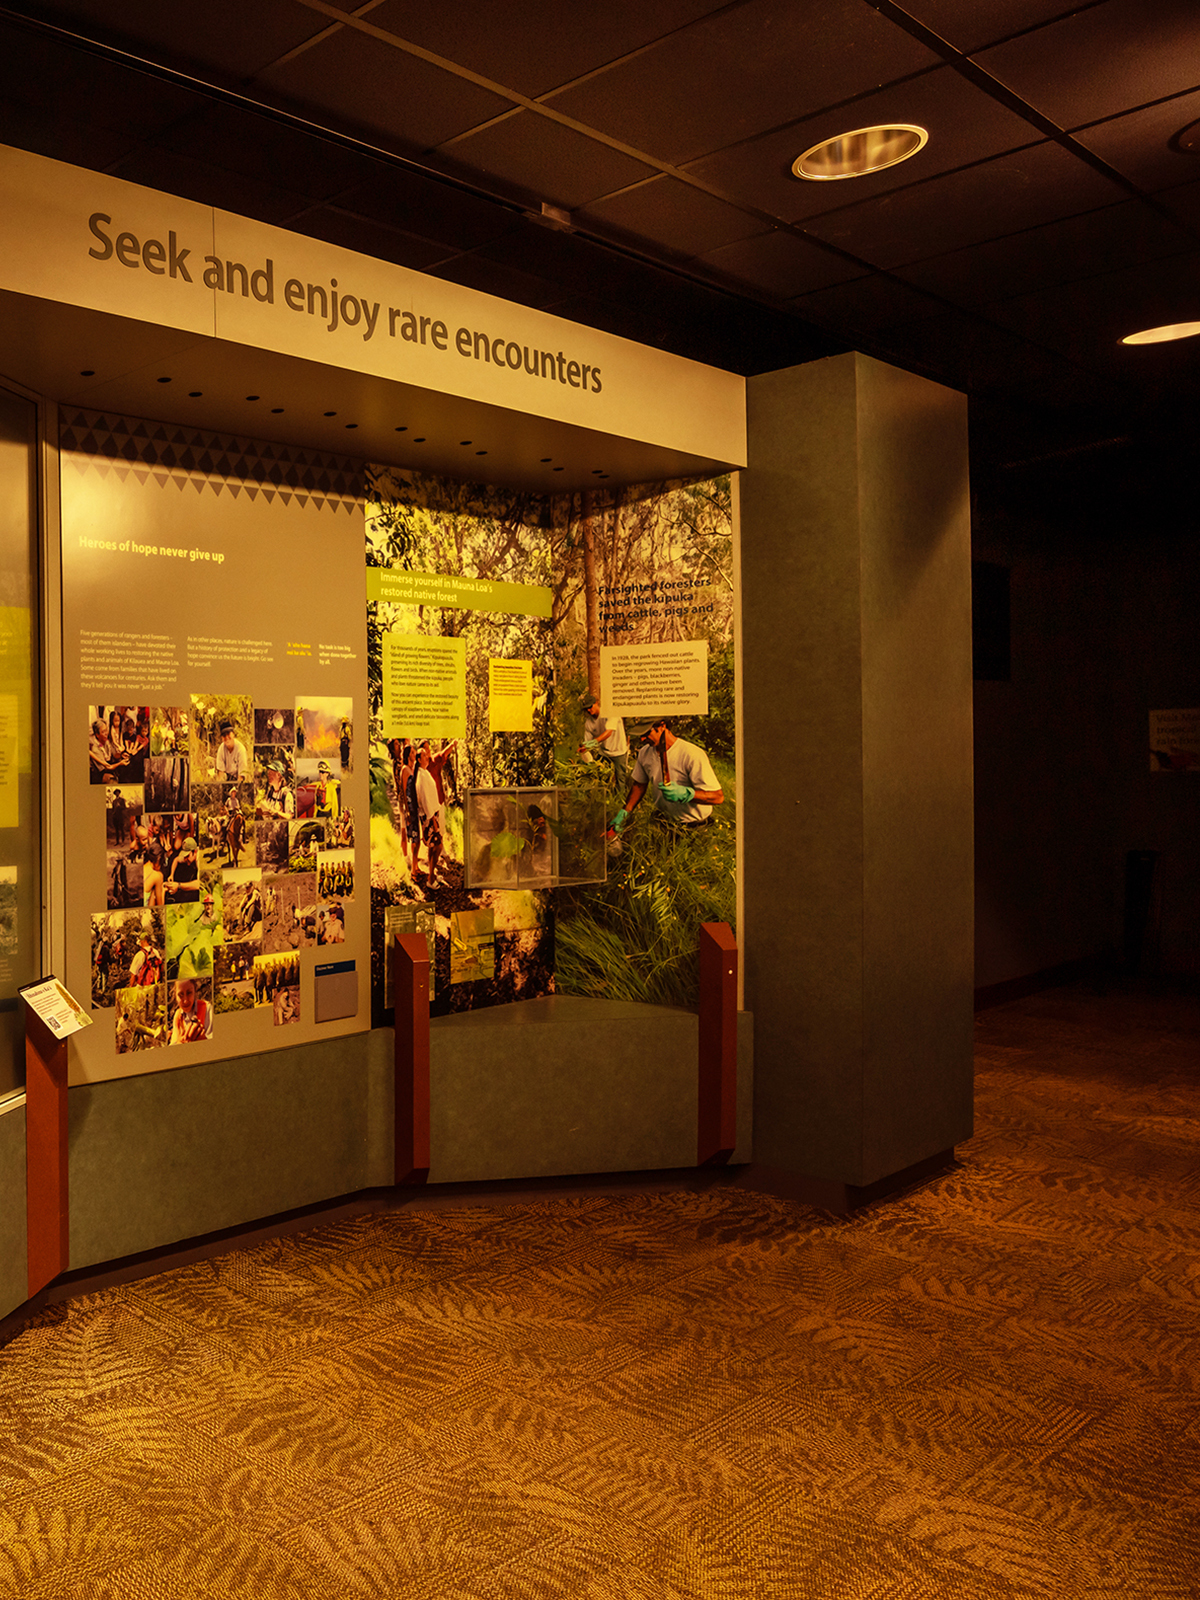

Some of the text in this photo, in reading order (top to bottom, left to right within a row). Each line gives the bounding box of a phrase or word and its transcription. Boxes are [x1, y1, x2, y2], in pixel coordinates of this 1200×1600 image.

[88, 212, 602, 394] Seek and enjoy rare encounters
[79, 536, 225, 564] Heroes of hope never give up
[380, 571, 413, 583] Immerse
[414, 577, 443, 587] yourself
[444, 578, 451, 588] in
[452, 580, 474, 591] Mauna
[598, 578, 711, 595] Farsighted foresters
[381, 588, 457, 602] restored native forest
[599, 597, 630, 608] saved
[633, 595, 651, 605] the
[599, 603, 714, 620] from cattle, pigs and
[599, 623, 634, 633] weeds
